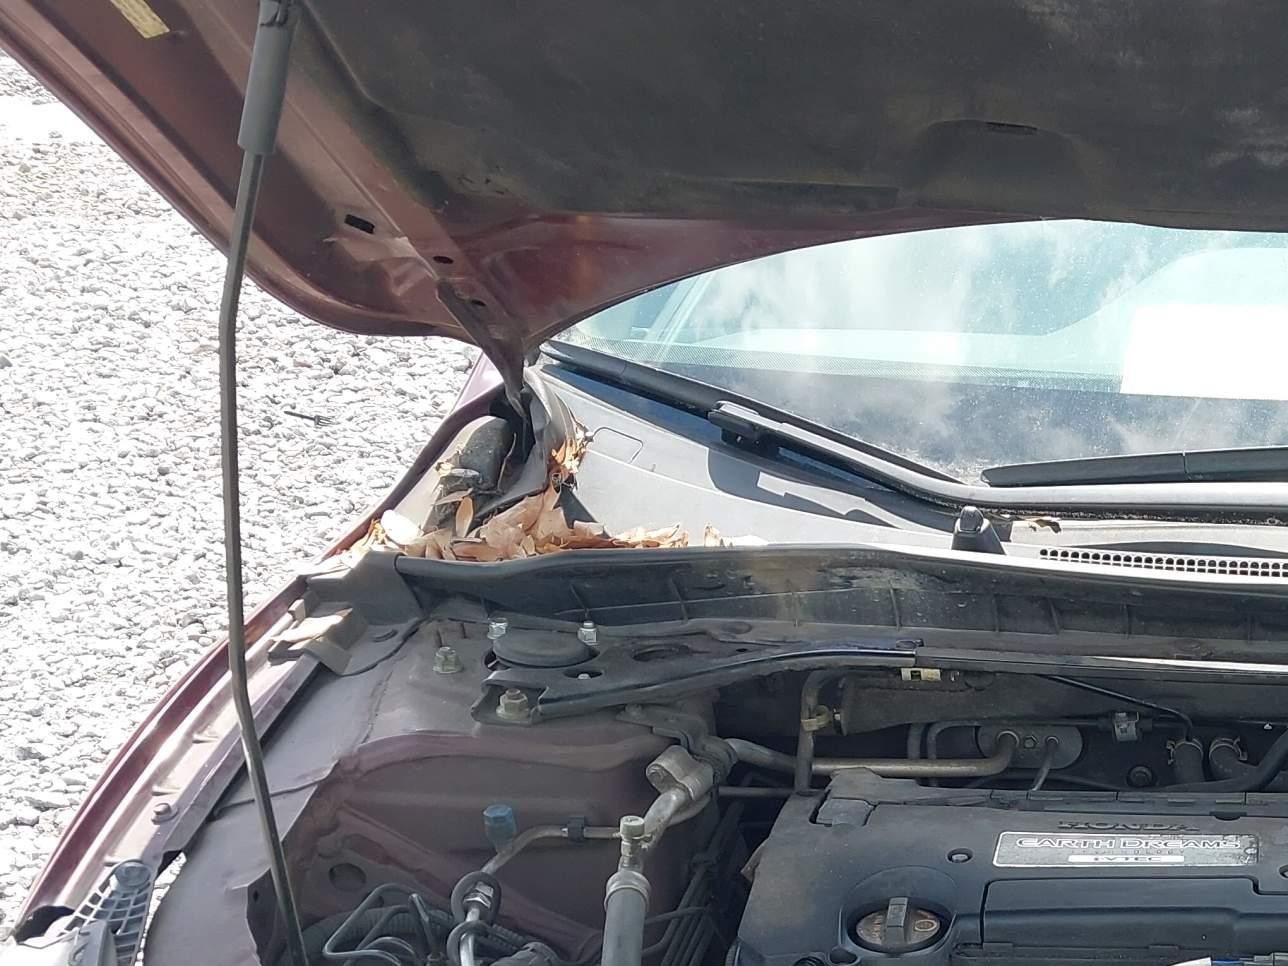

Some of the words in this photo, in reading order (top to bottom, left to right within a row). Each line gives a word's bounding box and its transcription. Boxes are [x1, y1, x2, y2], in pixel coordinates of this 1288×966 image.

[1058, 820, 1200, 831] HONDA
[1016, 837, 1115, 849] EARTH
[1119, 837, 1241, 850] DREAMS
